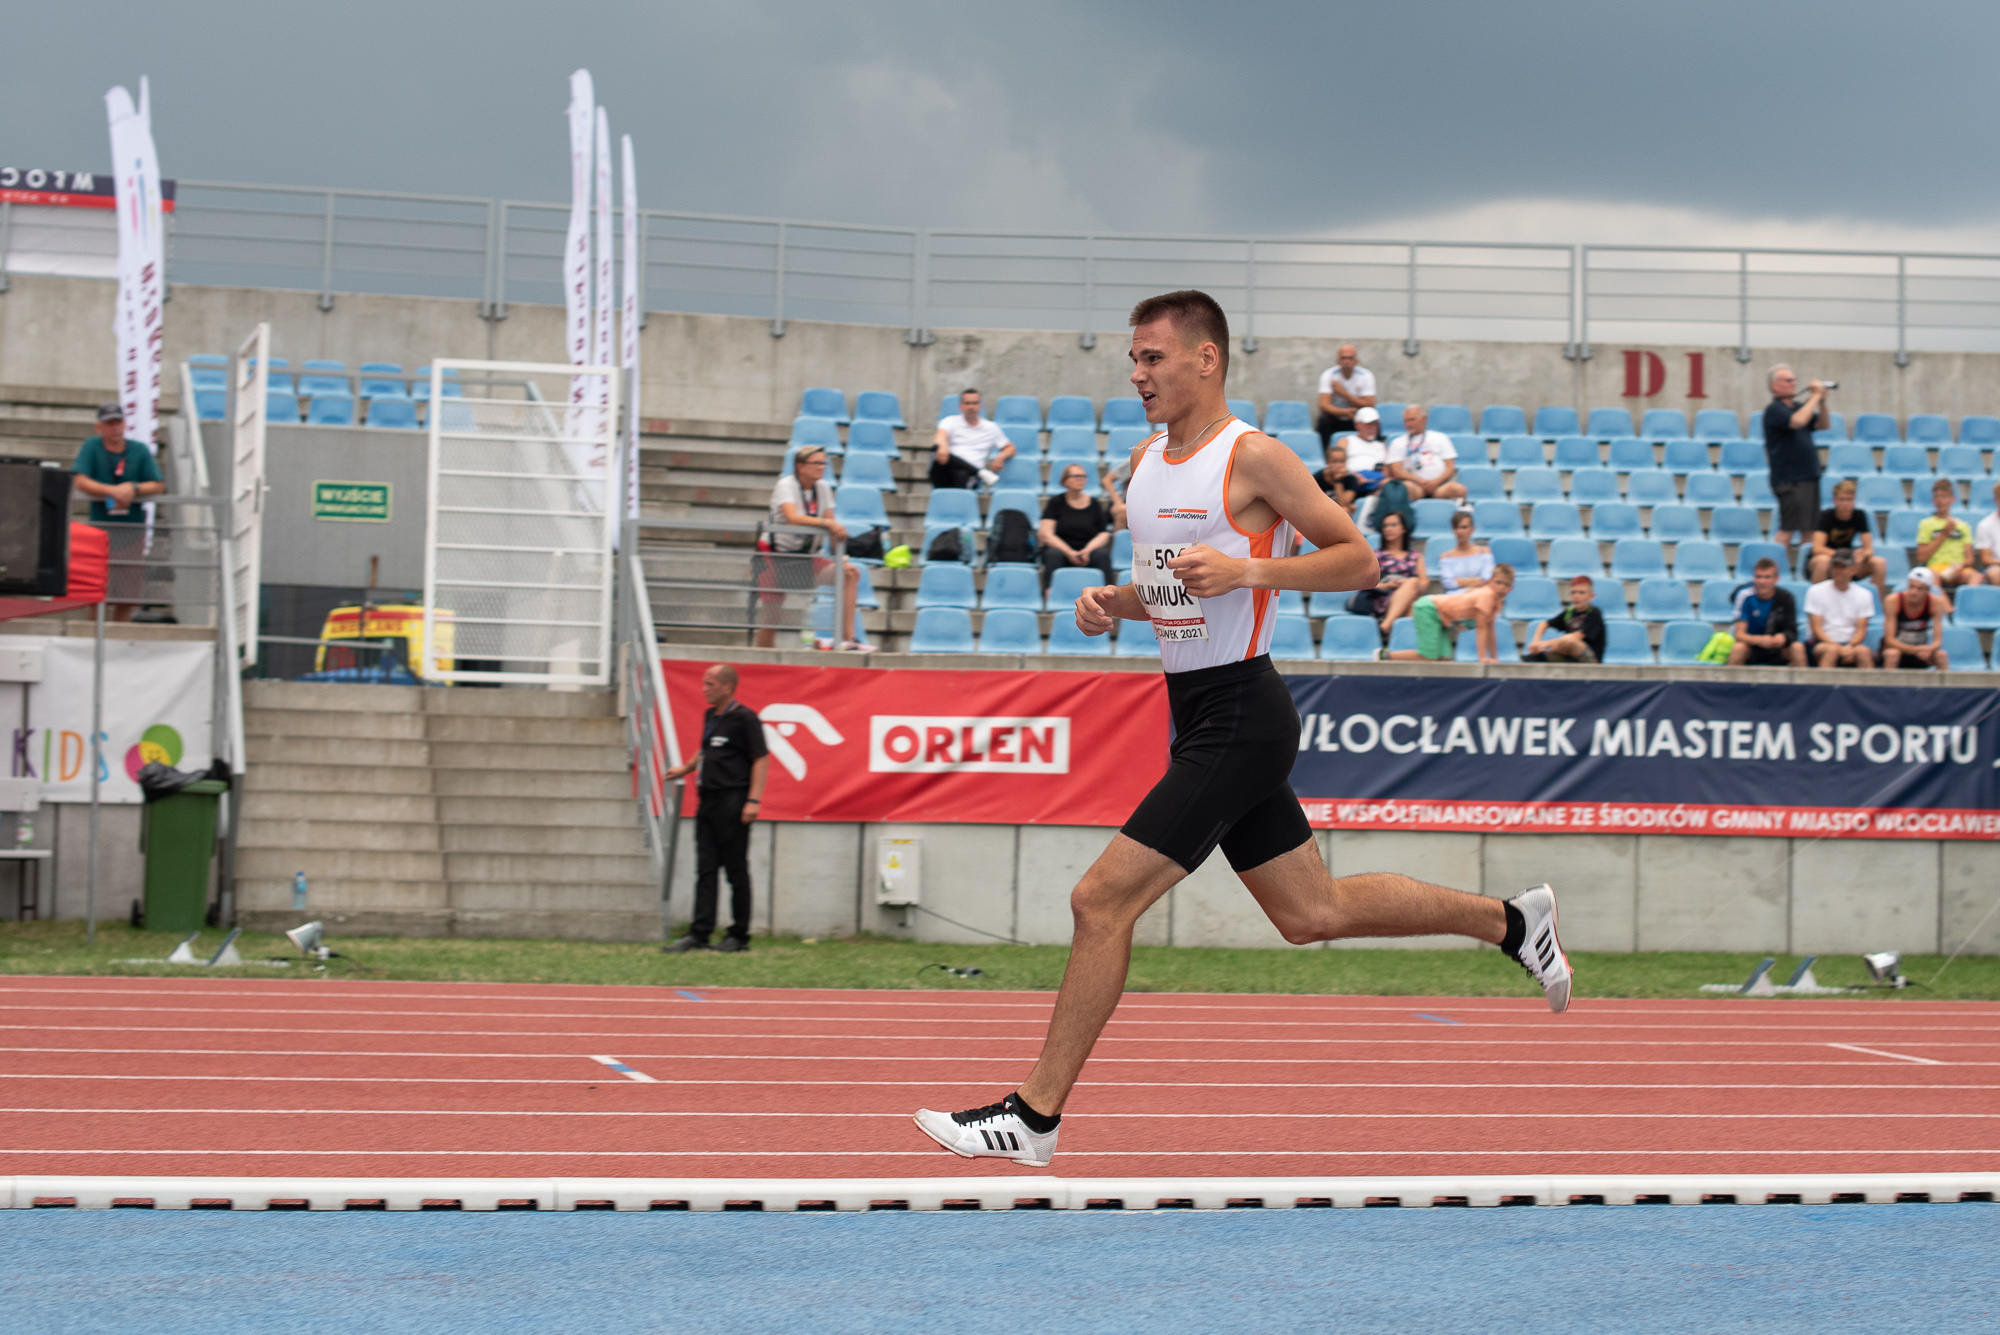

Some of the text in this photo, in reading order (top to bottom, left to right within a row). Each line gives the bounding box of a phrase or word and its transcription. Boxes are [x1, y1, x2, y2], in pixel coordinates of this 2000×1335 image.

[1155, 548, 1186, 570] 50
[1135, 584, 1194, 606] KLIMIUK
[1180, 628, 1203, 639] 2021
[12, 728, 109, 782] KIDS
[884, 725, 1054, 763] ORLEN
[1589, 718, 1796, 760] MIASTEM
[1808, 722, 1978, 764] SPORTU
[1337, 799, 1566, 826] WSPÓŁFINANSOWANE
[1571, 806, 1594, 826] ZE
[1600, 803, 1707, 829] ŚRODKÓW
[1711, 808, 1785, 830] GMINY
[1789, 811, 1873, 832] MIASTO
